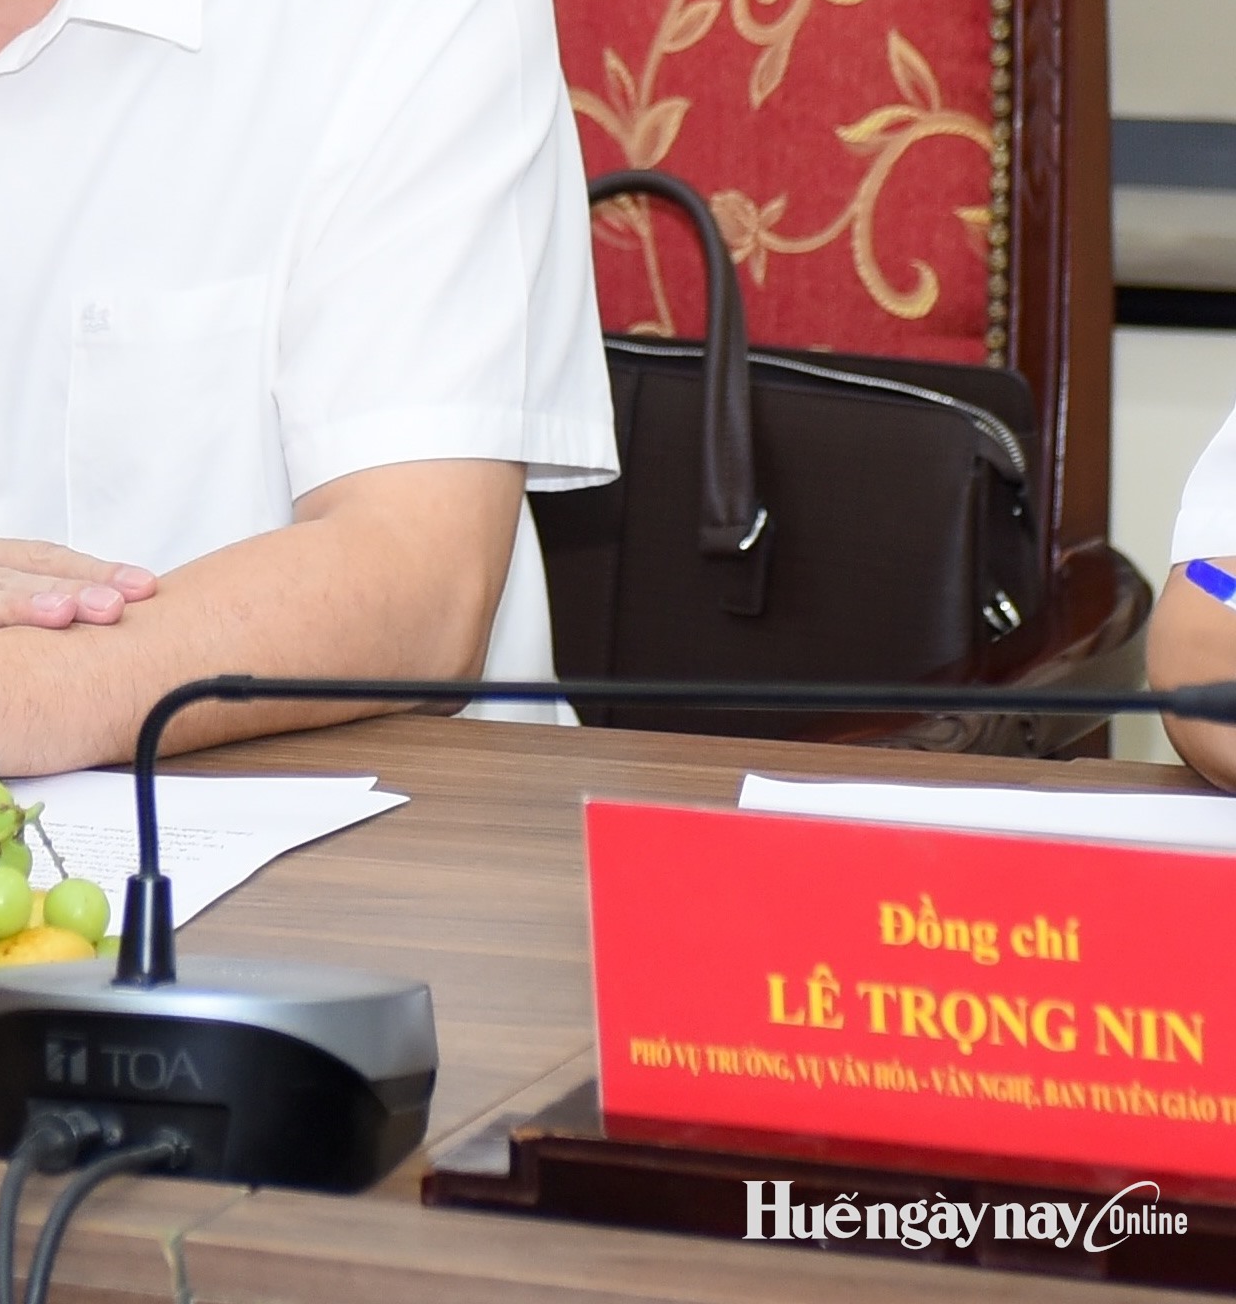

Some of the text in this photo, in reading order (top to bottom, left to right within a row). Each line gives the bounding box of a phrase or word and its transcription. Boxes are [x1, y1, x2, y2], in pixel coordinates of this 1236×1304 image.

[879, 893, 1081, 966] Đồng chí
[767, 962, 1205, 1066] LÊ TRỌNG NIN
[100, 1048, 203, 1090] TOA
[630, 1034, 672, 1068] PHÓ
[674, 1042, 702, 1077] VỤ
[796, 1052, 825, 1090] VỤ
[1043, 1077, 1087, 1109] BAN
[1090, 1080, 1159, 1116] TUYÊN
[1161, 1085, 1218, 1123] GIÁO
